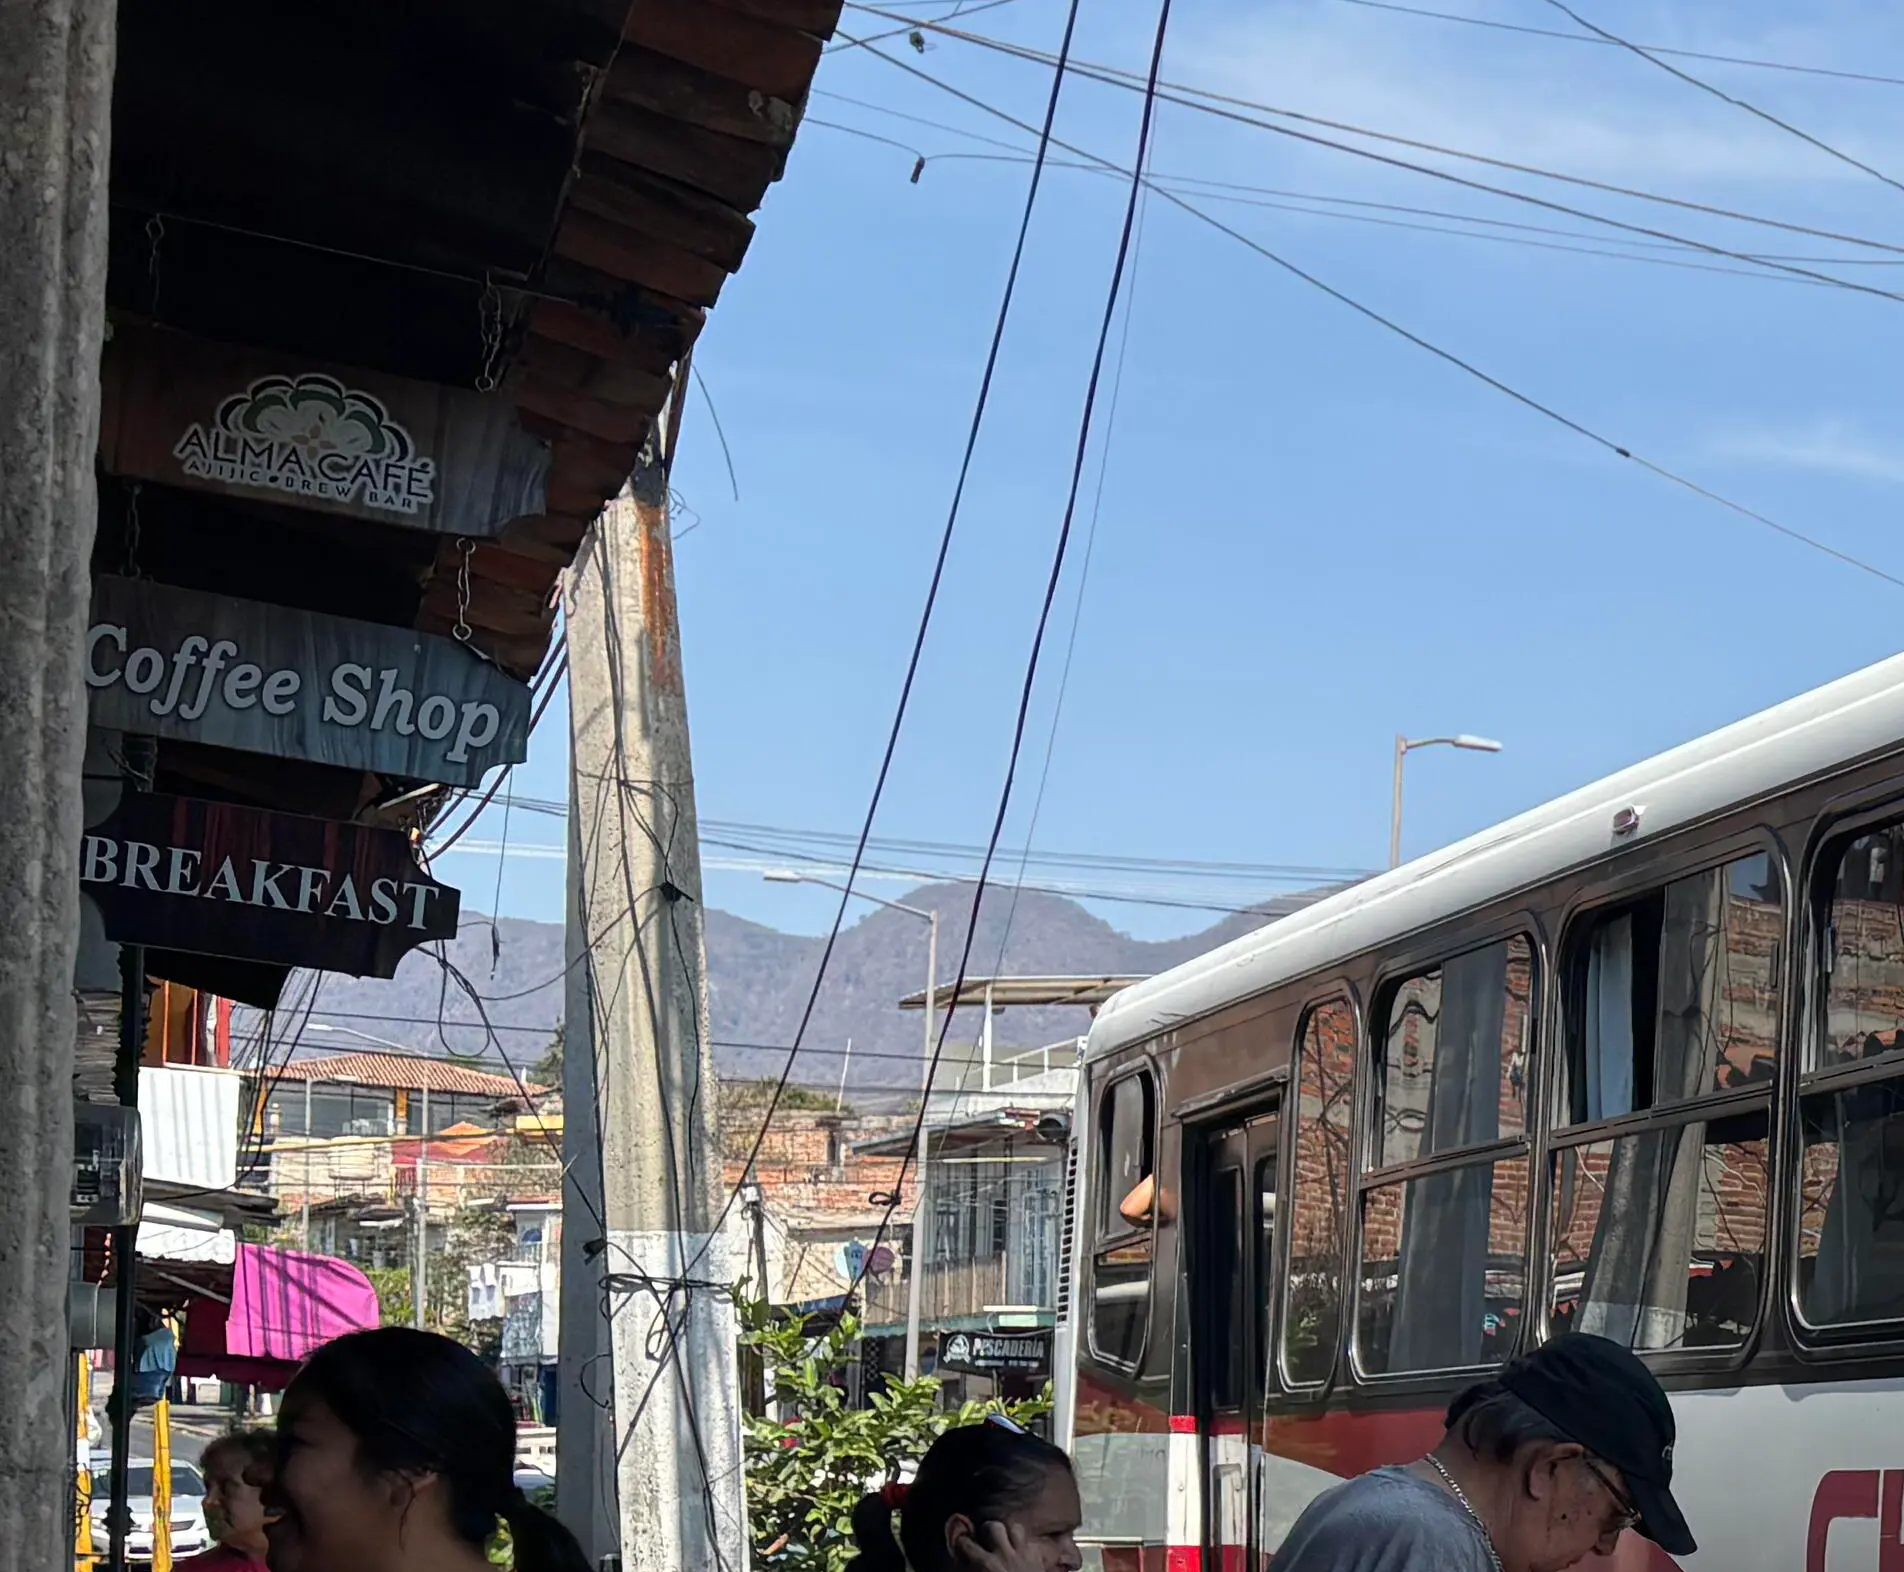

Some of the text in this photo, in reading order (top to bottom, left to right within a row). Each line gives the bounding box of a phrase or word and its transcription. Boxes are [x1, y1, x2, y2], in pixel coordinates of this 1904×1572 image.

[179, 428, 304, 475] ALMA
[188, 462, 412, 510] AJIJIC BREW BAR
[85, 624, 500, 763] Coffee Shop
[80, 836, 439, 930] BREAKFAST
